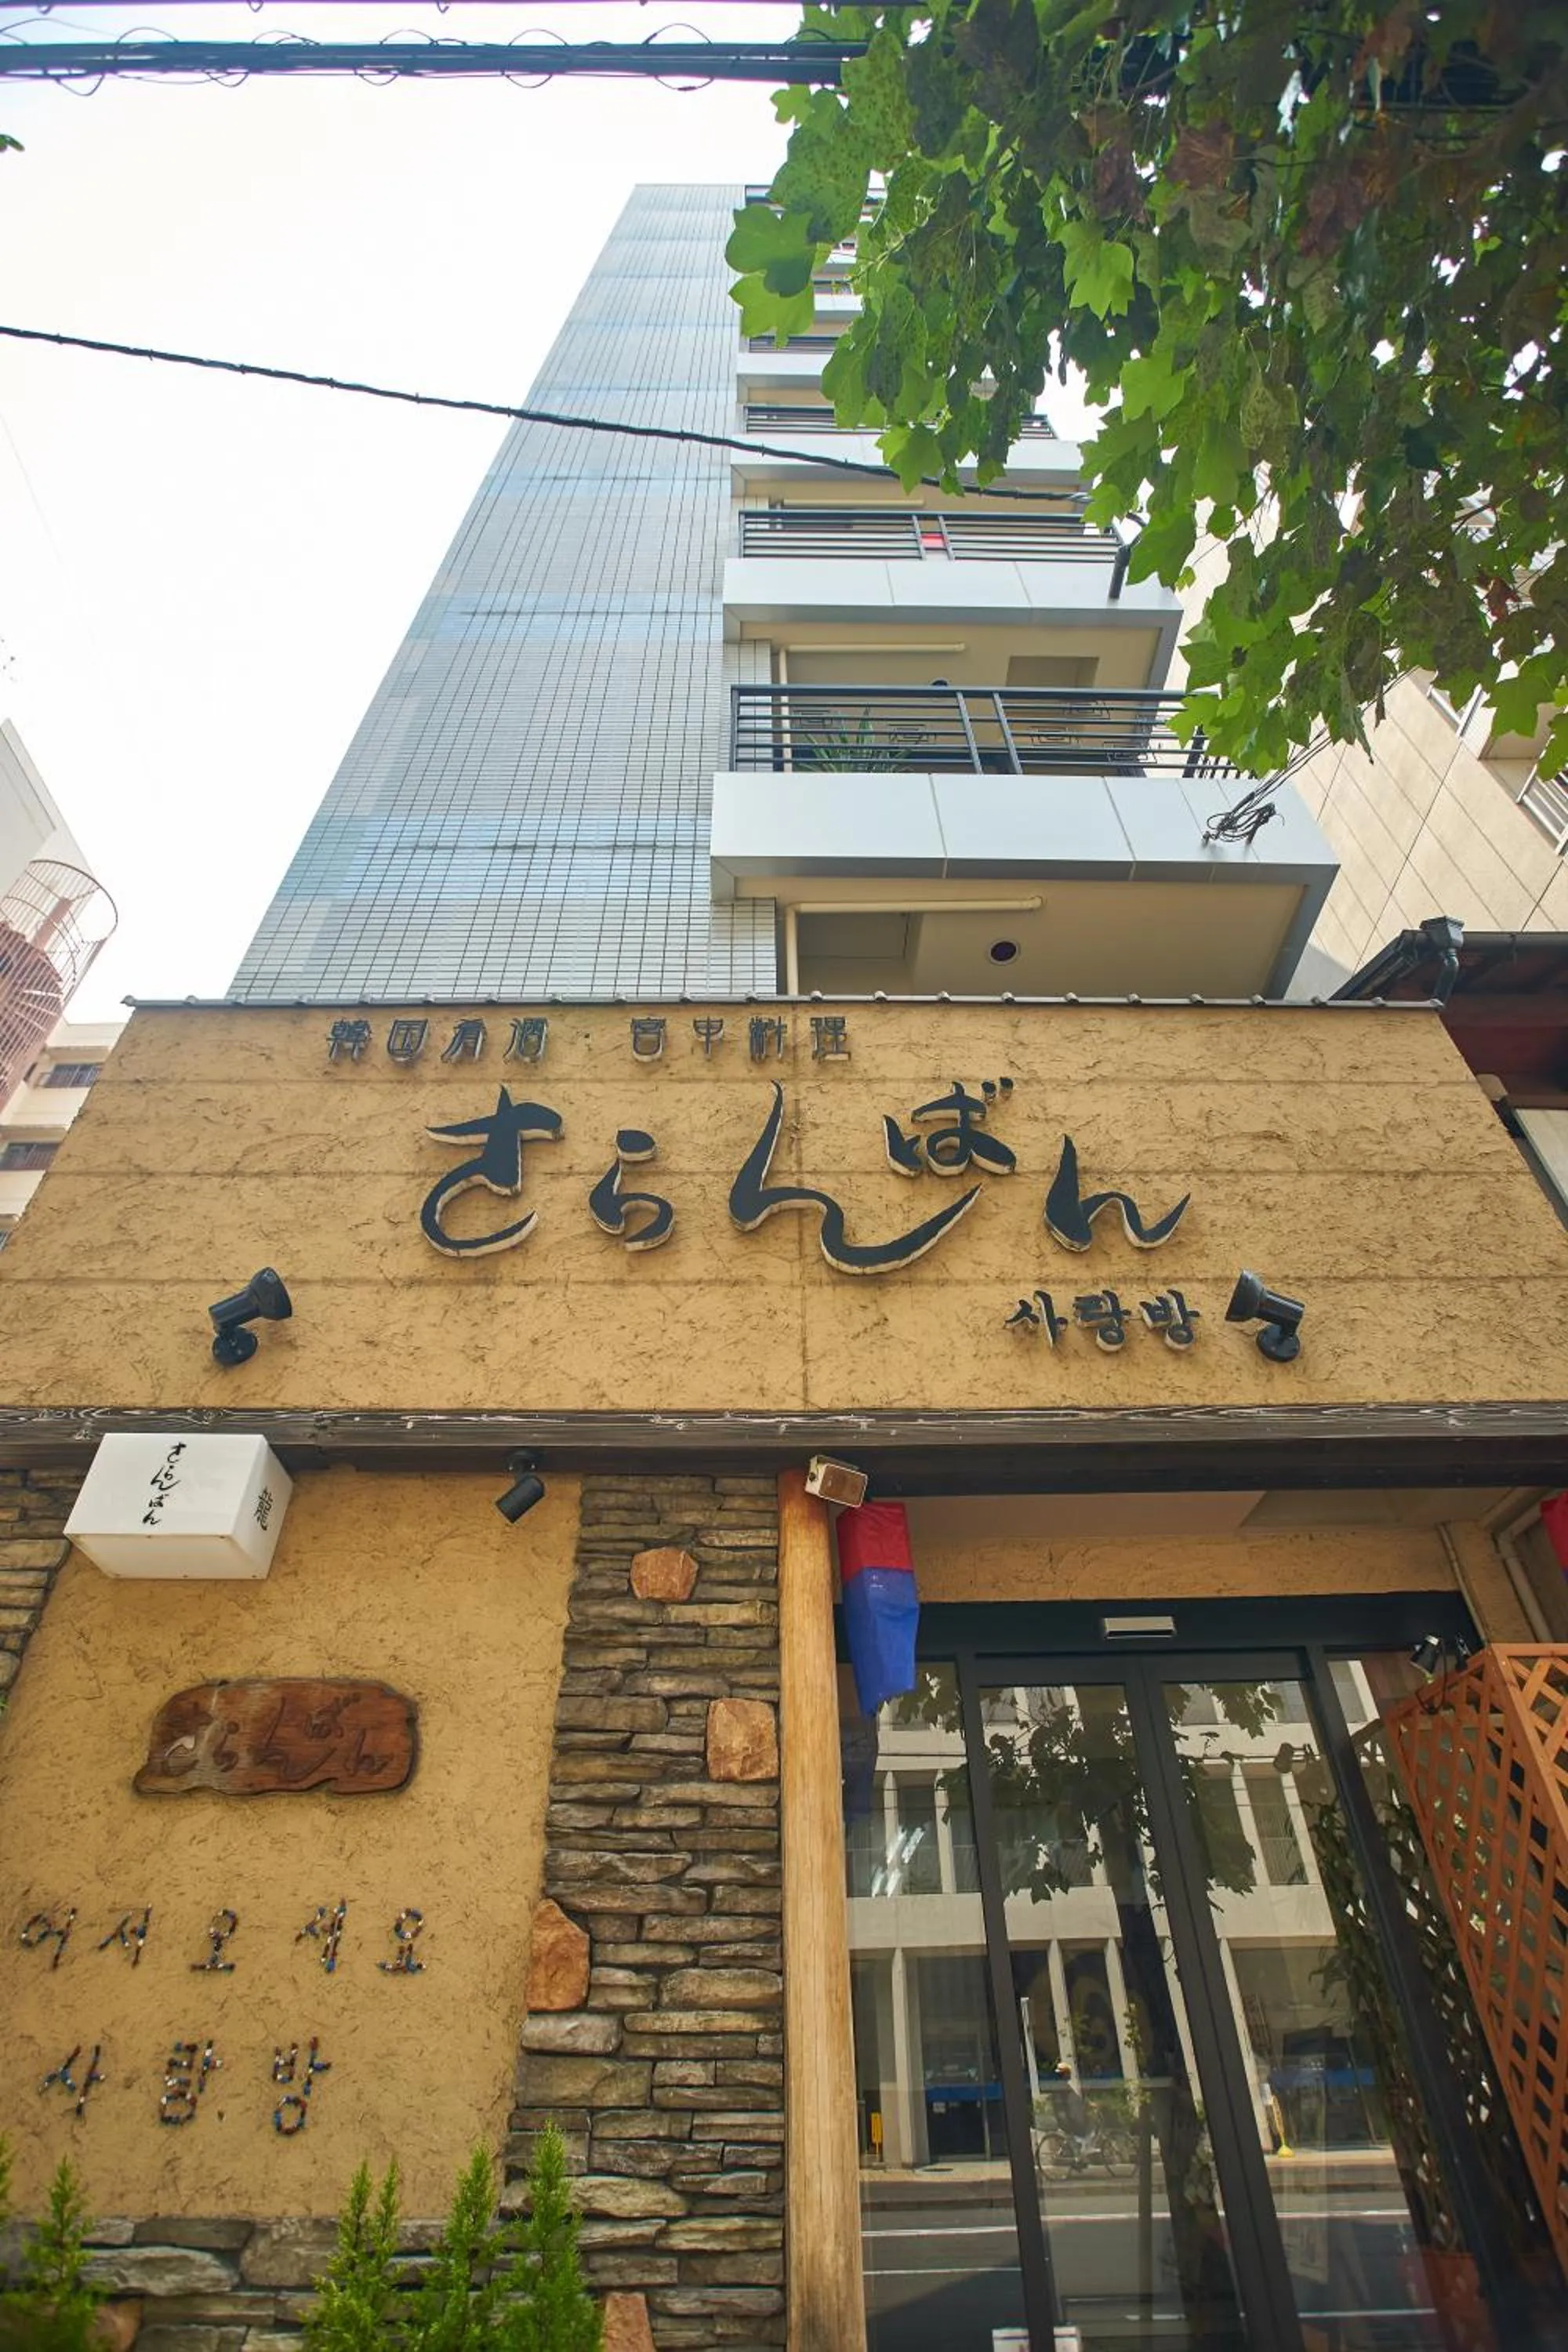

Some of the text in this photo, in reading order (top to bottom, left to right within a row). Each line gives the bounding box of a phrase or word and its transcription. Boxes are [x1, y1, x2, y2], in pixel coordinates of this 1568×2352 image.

[419, 1077, 1191, 1276] さらんばん
[1004, 1290, 1200, 1352] 사랑방
[142, 1442, 187, 1526] さらんばん
[20, 1897, 427, 1974] 어서 오세요
[38, 2036, 333, 2136] 사랑방
